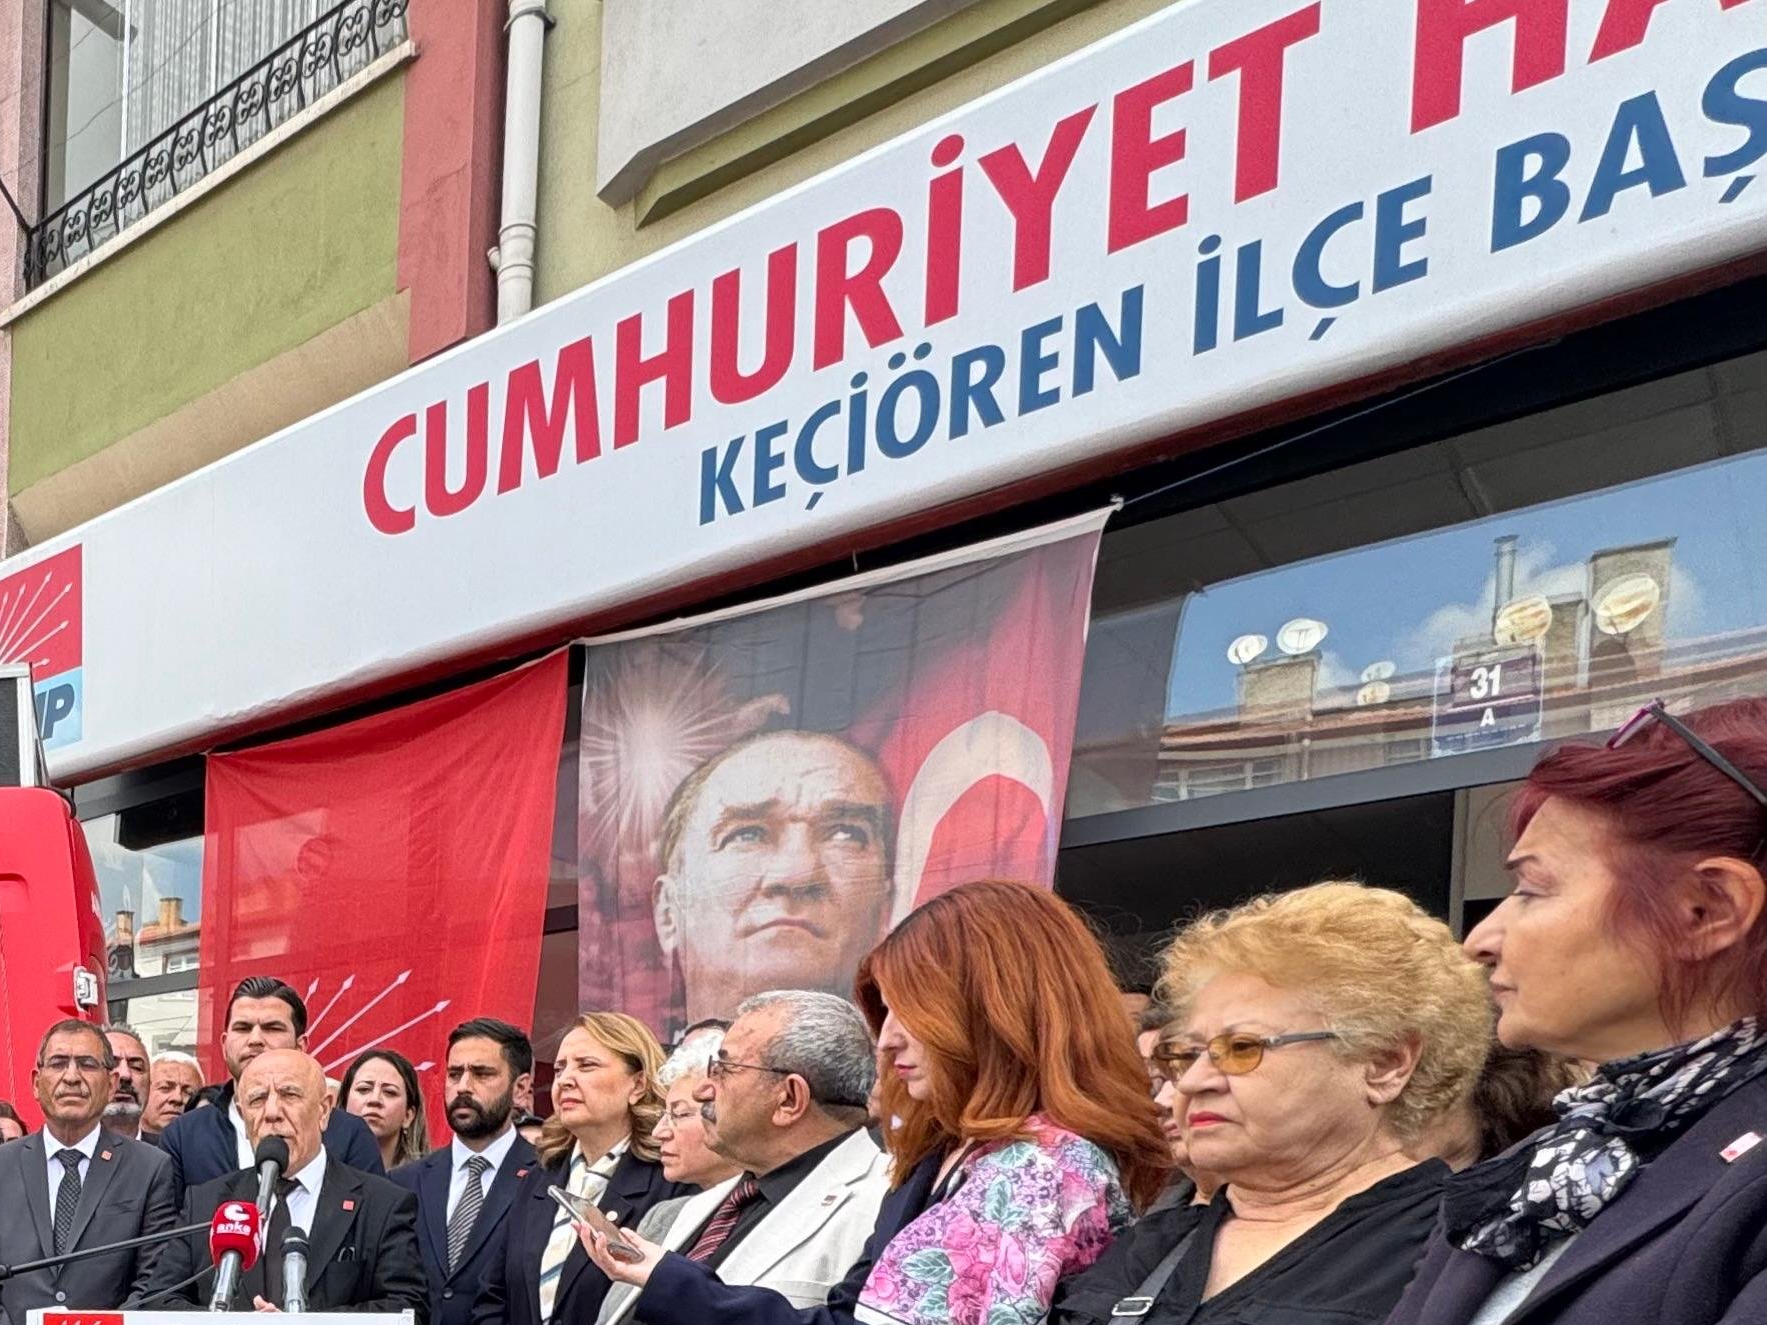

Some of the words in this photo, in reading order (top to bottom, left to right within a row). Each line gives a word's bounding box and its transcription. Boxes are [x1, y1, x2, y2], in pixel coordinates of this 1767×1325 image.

[364, 4, 1320, 534] CUMHURİYET
[700, 286, 1144, 524] KEÇİÖREN
[1194, 176, 1431, 352] İLÇE
[1470, 664, 1502, 699] 31
[1479, 707, 1496, 728] A
